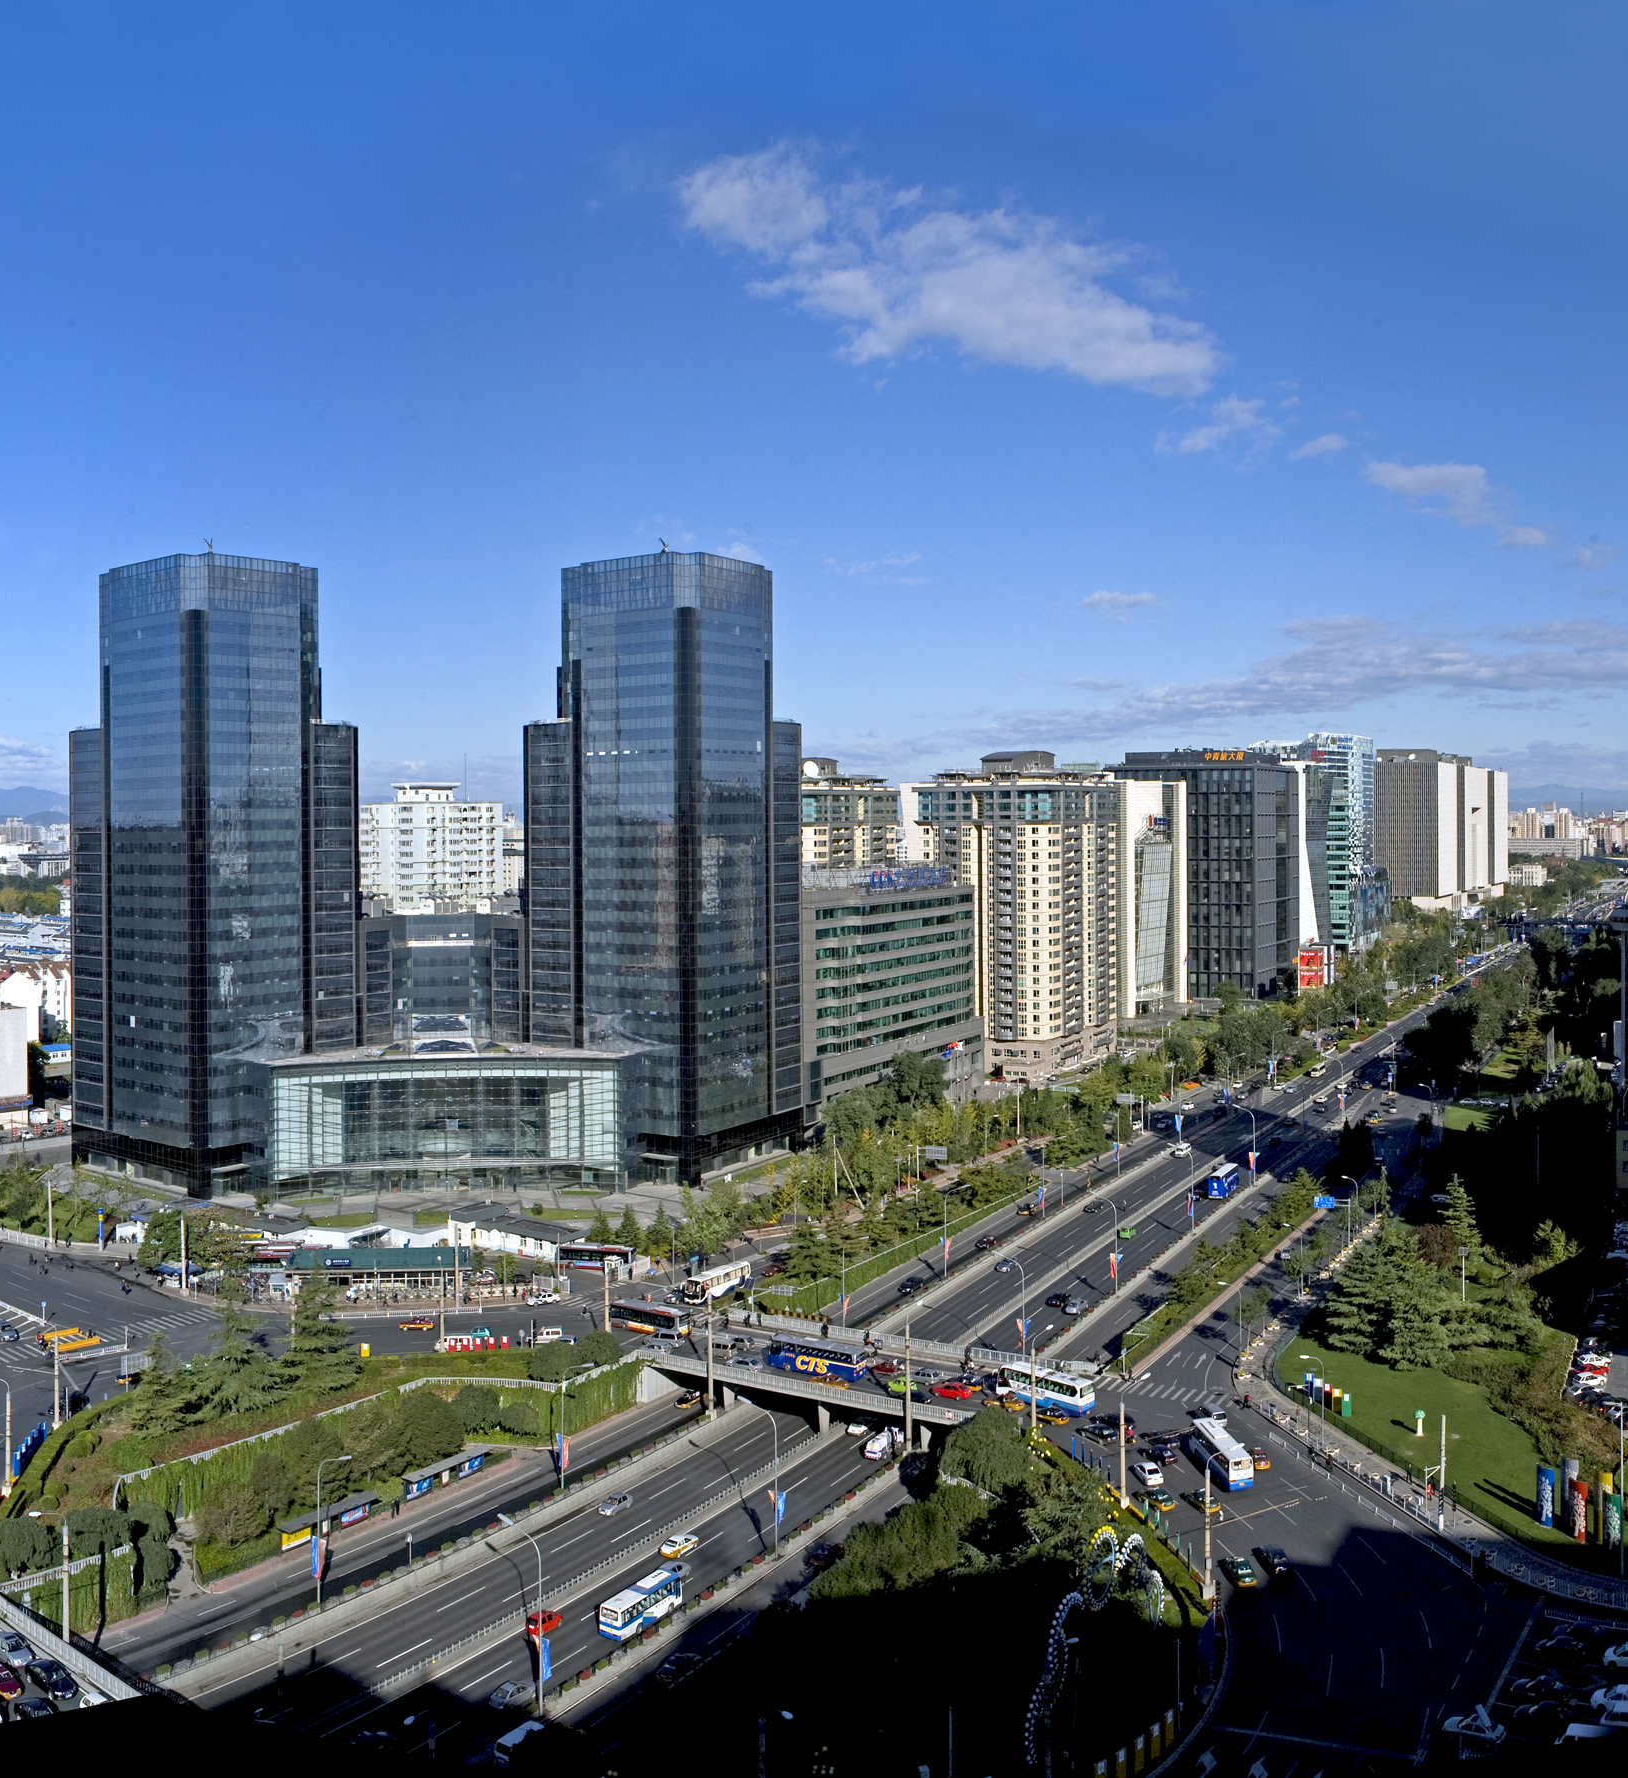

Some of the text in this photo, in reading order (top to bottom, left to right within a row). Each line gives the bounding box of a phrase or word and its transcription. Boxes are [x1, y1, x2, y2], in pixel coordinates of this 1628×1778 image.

[1204, 751, 1245, 761] 中青旅大厦
[795, 1354, 829, 1374] CTS
